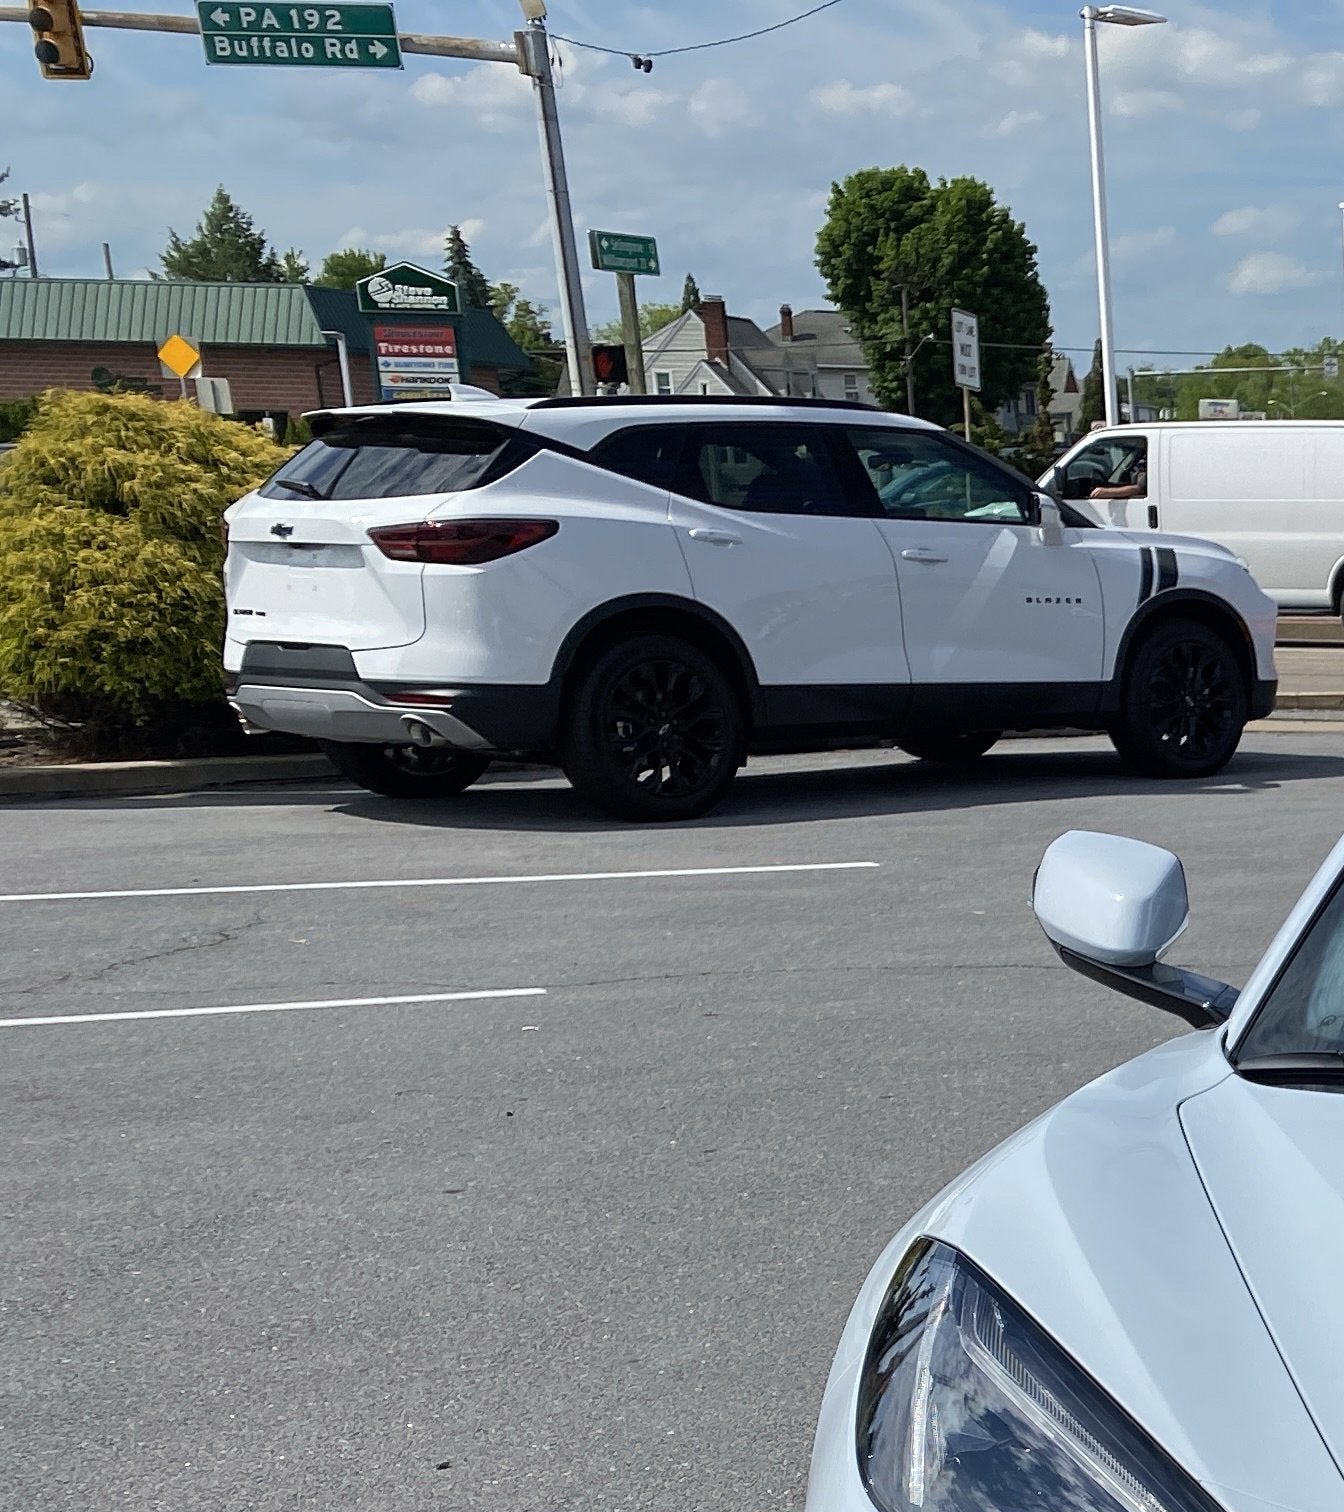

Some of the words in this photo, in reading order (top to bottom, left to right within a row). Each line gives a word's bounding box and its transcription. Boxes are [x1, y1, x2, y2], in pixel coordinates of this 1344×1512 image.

[239, 7, 280, 29] PA
[289, 8, 343, 30] 192
[213, 36, 314, 58] Buffalo
[324, 38, 359, 59] Rd
[378, 342, 454, 354] Firestone
